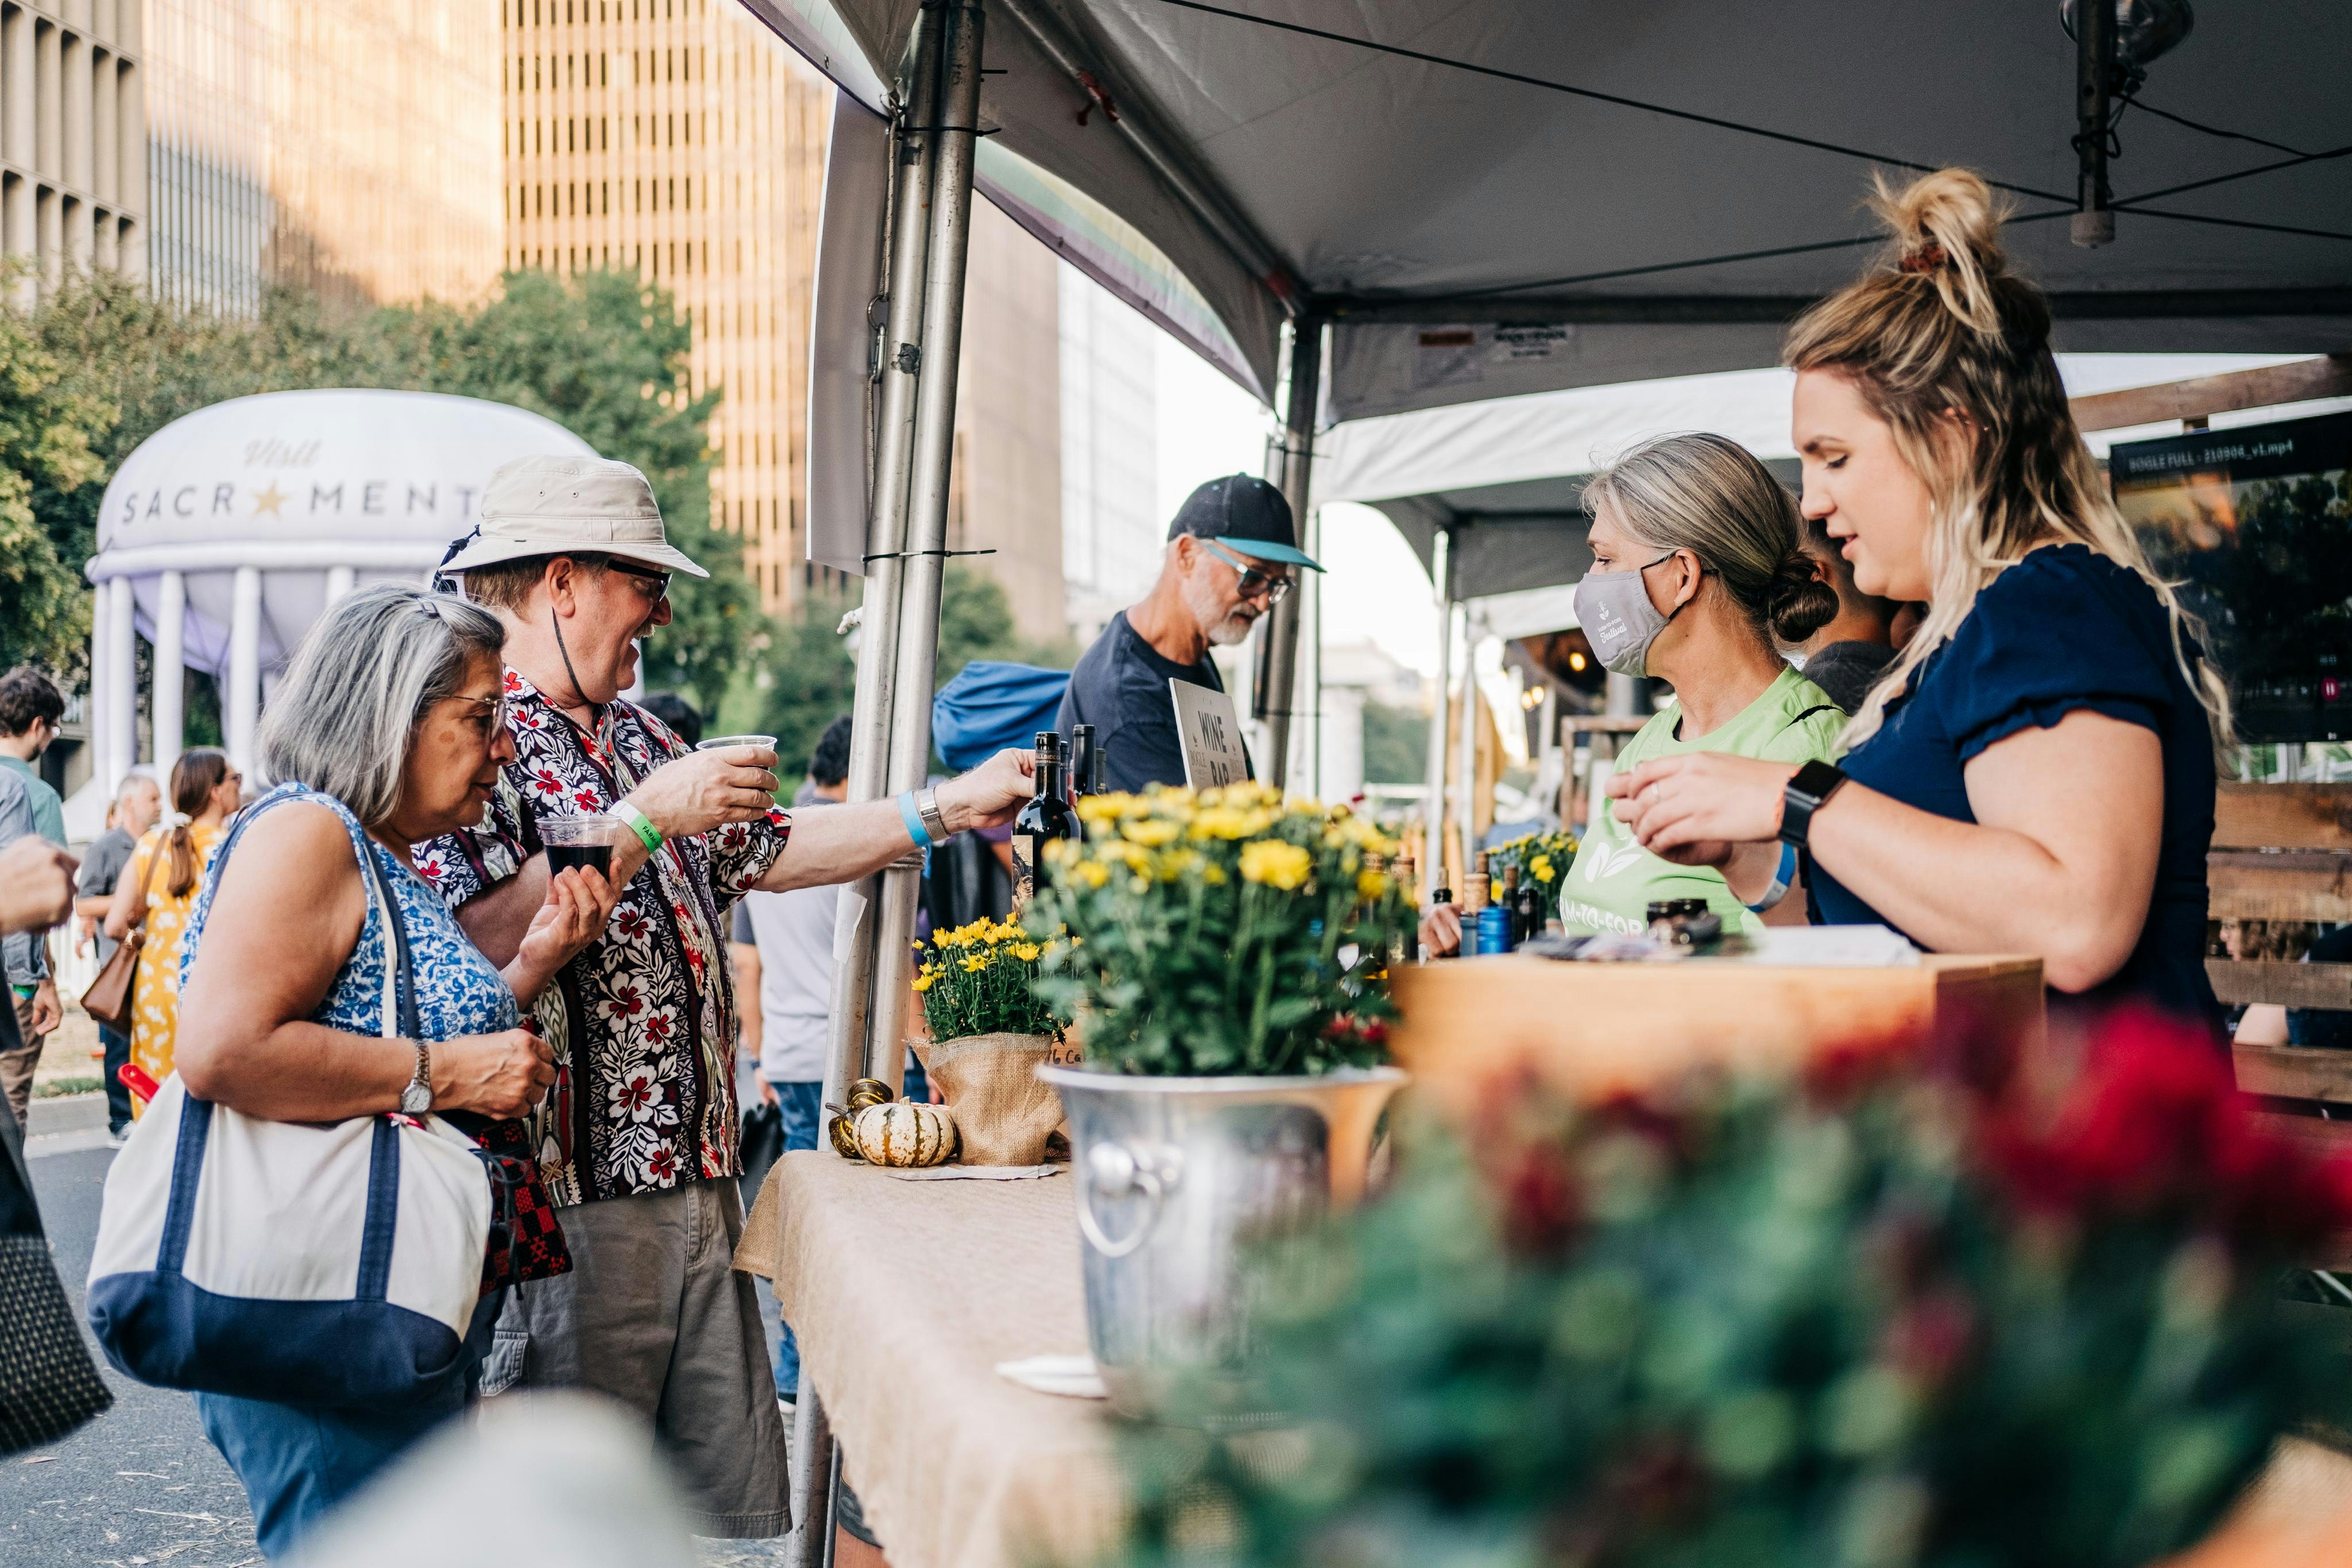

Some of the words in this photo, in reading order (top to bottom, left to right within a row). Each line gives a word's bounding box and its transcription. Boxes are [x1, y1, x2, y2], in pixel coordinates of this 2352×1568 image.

[243, 436, 323, 471] Visit
[1600, 622, 1627, 644] Festival
[1198, 710, 1227, 753] WINE
